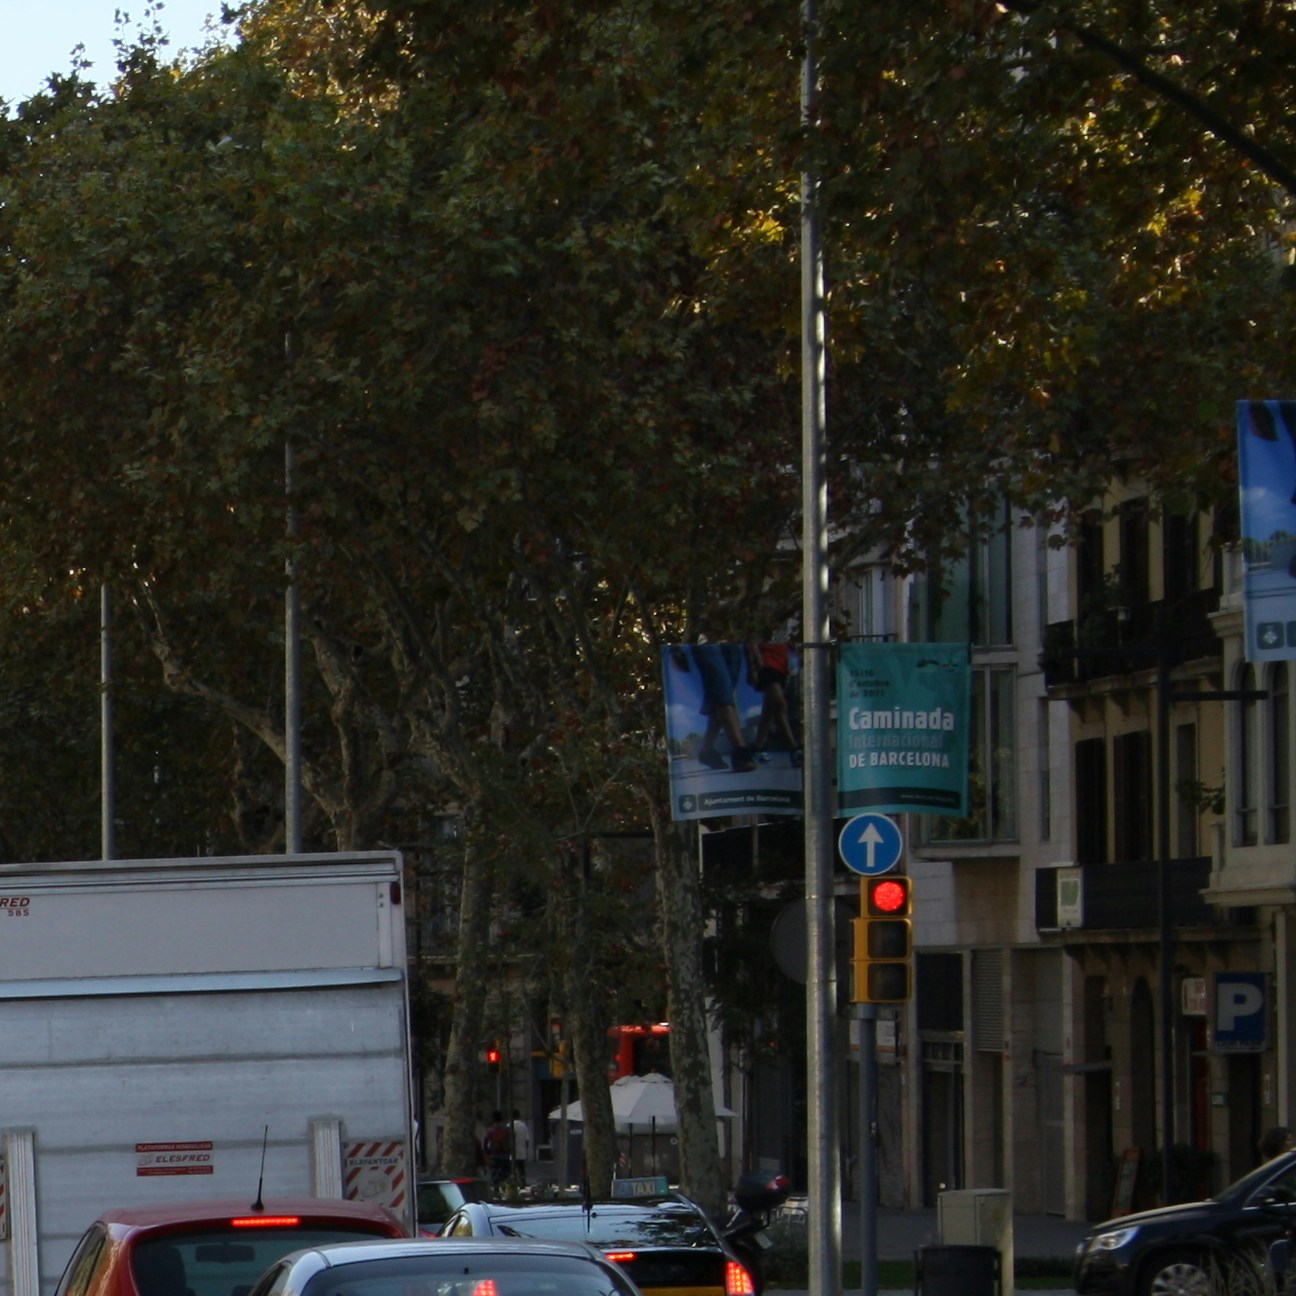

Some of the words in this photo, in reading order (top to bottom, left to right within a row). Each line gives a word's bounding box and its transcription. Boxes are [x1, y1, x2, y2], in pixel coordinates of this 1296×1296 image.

[848, 706, 954, 731] Caminada
[849, 754, 866, 768] DE
[870, 751, 949, 768] BARCELONA
[704, 795, 745, 806] Ajuntament
[1217, 982, 1263, 1031] P
[155, 1154, 210, 1163] ELESFRED
[632, 1182, 656, 1196] TAXI
